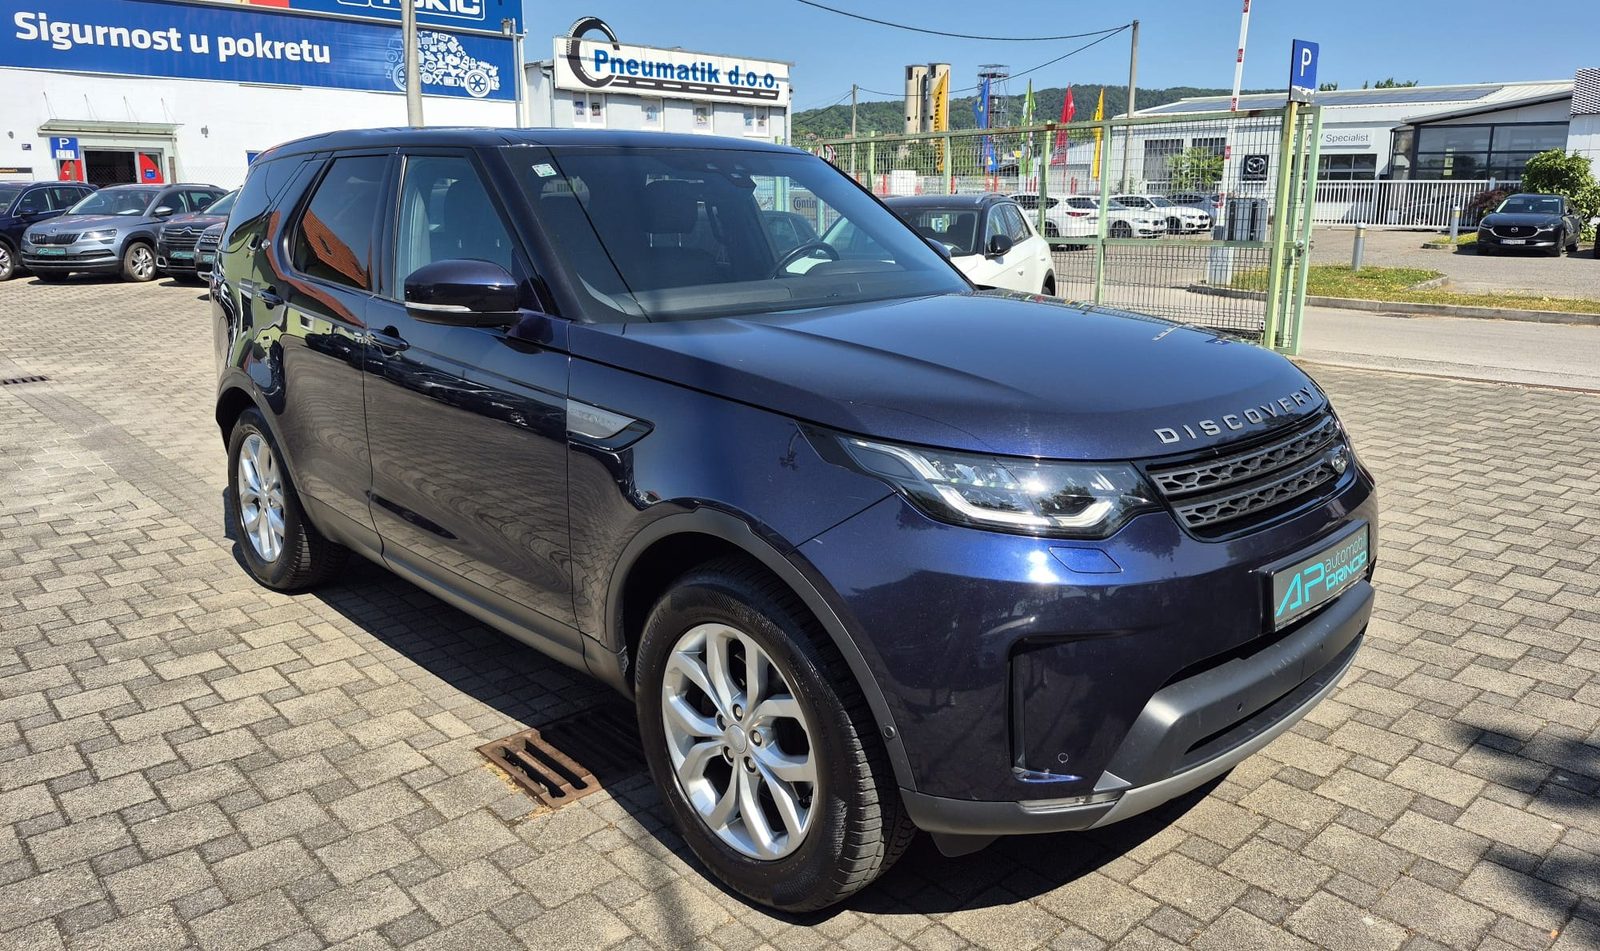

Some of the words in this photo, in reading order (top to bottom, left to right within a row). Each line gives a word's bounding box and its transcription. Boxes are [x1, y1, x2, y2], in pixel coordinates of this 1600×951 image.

[14, 11, 183, 52] Sigurnost
[190, 34, 209, 54] u
[218, 36, 331, 63] pokretu
[594, 49, 720, 84] Pneumatik
[728, 65, 780, 89] d.o.o.
[1300, 47, 1312, 77] P
[59, 138, 70, 149] P
[1325, 133, 1369, 143] Specialist
[1154, 386, 1315, 444] DISCOVERY
[1275, 562, 1325, 617] AP
